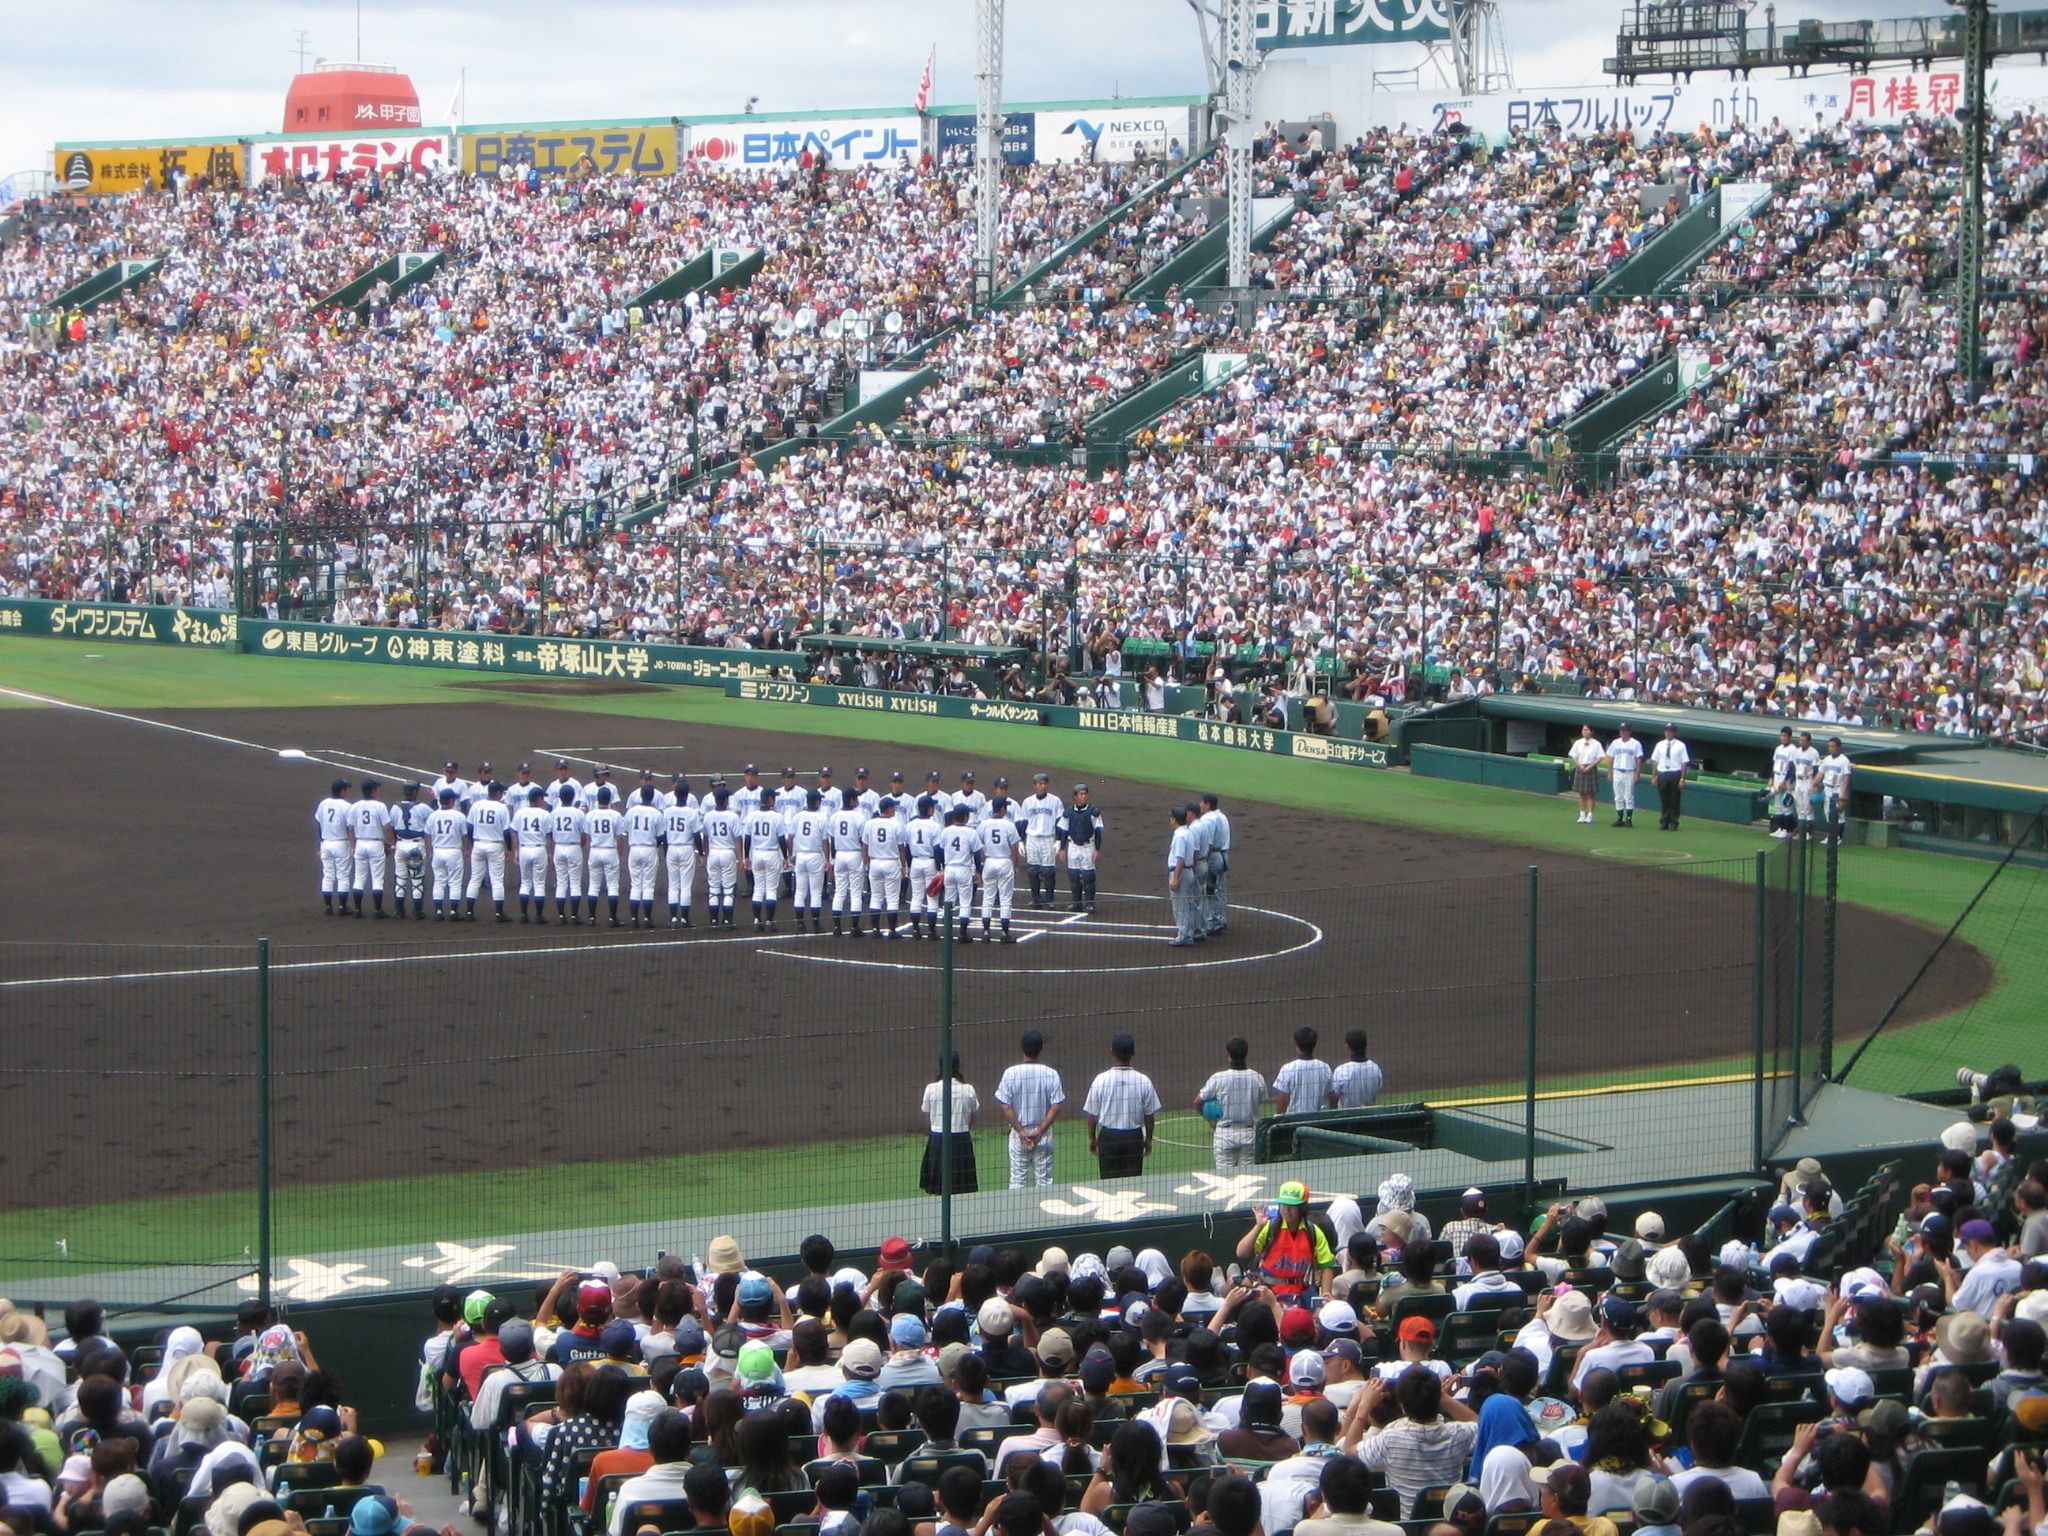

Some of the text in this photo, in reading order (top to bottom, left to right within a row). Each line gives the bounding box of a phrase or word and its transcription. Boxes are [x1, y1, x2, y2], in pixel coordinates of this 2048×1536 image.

[1847, 73, 1960, 118] 月桂冠
[1508, 87, 1682, 134] 日本フルハップ
[1712, 86, 1758, 124] nfh
[1110, 120, 1165, 133] NEXCO
[743, 128, 918, 163] 日本ペイント
[260, 138, 443, 182] オロナミンC
[50, 604, 156, 639] ダイワシステム
[286, 630, 378, 656] 東昌グループ
[407, 636, 505, 667] 神東塗料
[537, 642, 649, 679] 帝塚山大学
[759, 682, 810, 703] サニクリーン
[969, 703, 1040, 721] サークルKサンクス
[1198, 722, 1274, 751] 松本歯科大学
[1327, 743, 1388, 765] 日立電子サービス
[327, 808, 335, 822] 7
[362, 810, 371, 825] 3
[478, 809, 495, 825] 16
[436, 819, 453, 835] 17
[522, 817, 540, 832] 14
[556, 816, 572, 832] 12
[593, 818, 611, 834] 18
[633, 815, 649, 832] 11
[669, 816, 685, 832] 15
[712, 821, 728, 837] 13
[753, 821, 770, 837] 10
[802, 821, 811, 836] 6
[839, 820, 848, 836] 8
[877, 827, 887, 843] 9
[916, 829, 924, 844] 1
[991, 829, 1001, 844] 5
[951, 836, 961, 851] 4
[569, 1349, 610, 1360] Gutte
